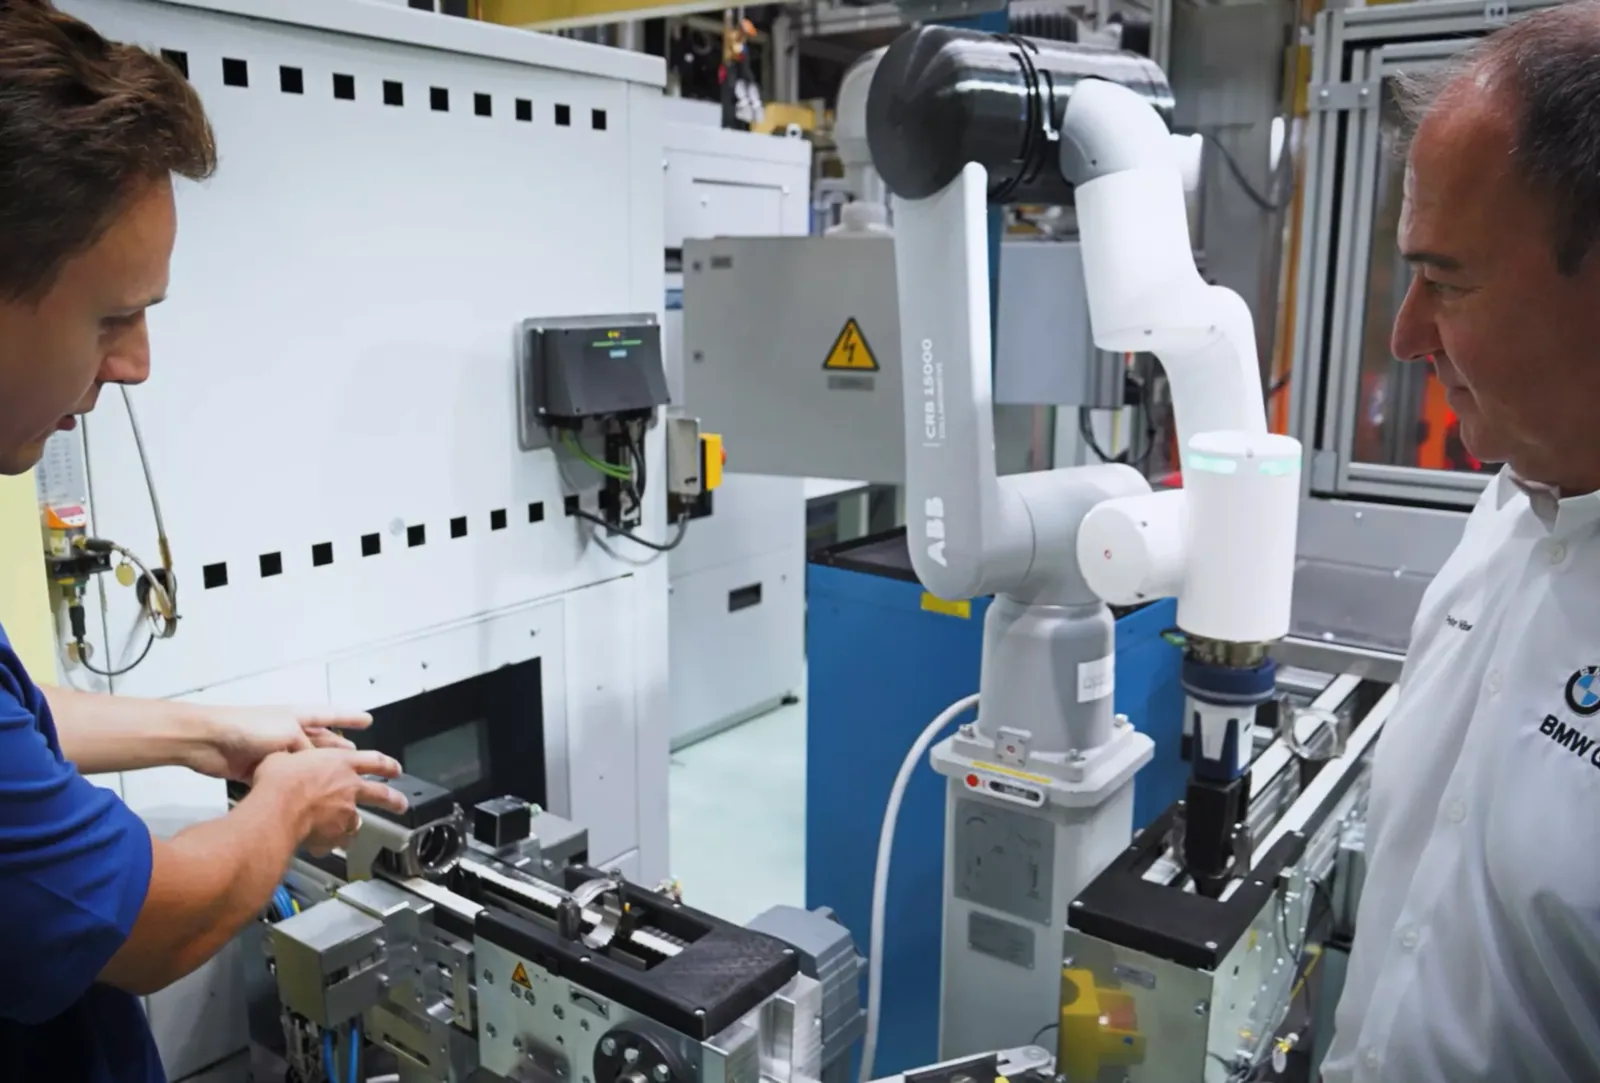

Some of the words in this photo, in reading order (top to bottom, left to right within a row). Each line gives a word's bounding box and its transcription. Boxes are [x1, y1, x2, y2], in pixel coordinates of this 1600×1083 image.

[921, 339, 933, 395] 15000
[924, 401, 936, 439] CRB
[925, 496, 948, 568] ABB
[1539, 713, 1596, 757] BMW
